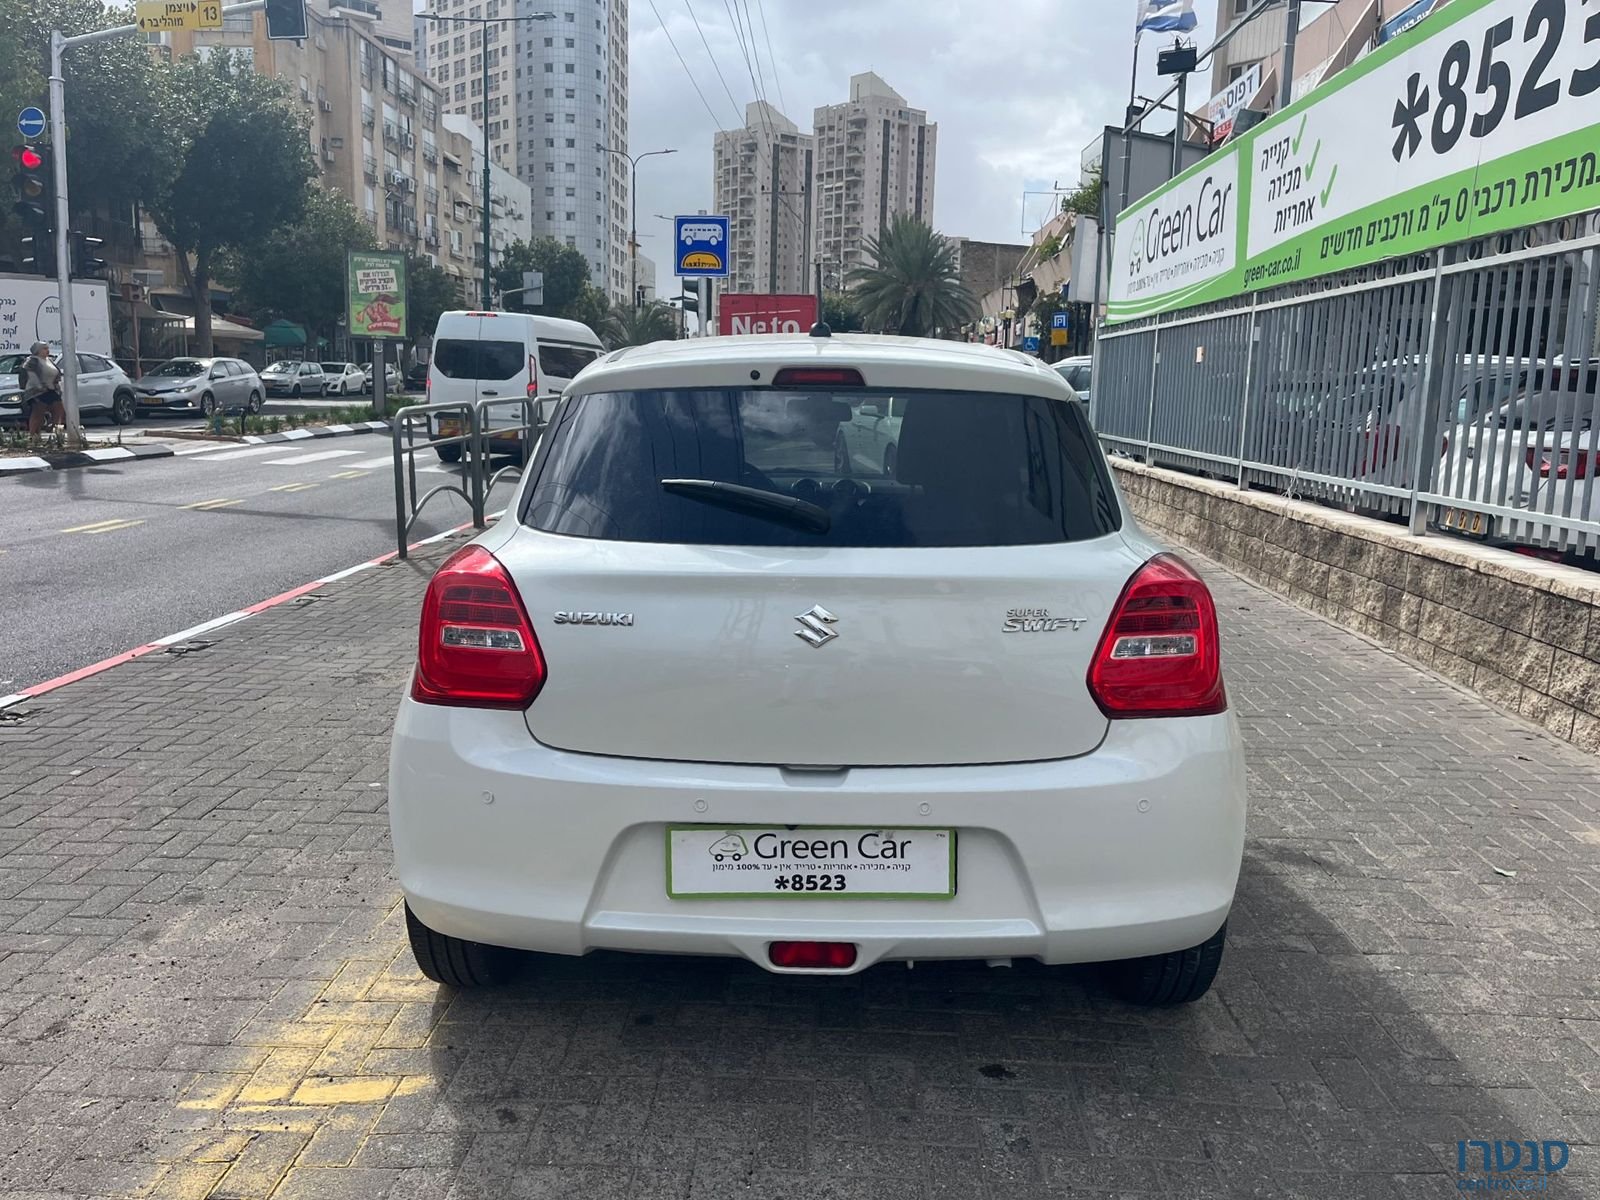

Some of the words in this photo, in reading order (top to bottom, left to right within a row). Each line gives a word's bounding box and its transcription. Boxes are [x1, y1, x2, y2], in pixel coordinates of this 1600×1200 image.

[165, 3, 189, 16] ויצמן
[203, 6, 218, 21] 13
[147, 15, 184, 27] מוהליבר
[1226, 73, 1254, 110] דפוס
[1261, 136, 1291, 172] קנייה
[1268, 165, 1302, 202] מכירה
[1520, 151, 1600, 206] מכירת
[1473, 178, 1516, 217] רכבי
[1146, 204, 1192, 264] Green
[1196, 176, 1232, 242] Car
[1273, 195, 1316, 234] אחריות
[1366, 208, 1415, 246] ורכבים
[1319, 226, 1363, 260] חדשים
[1243, 247, 1302, 289] green-car.co.il
[2, 325, 18, 337] לקוח
[731, 316, 800, 335] Neto
[553, 610, 635, 626] SUZUKI
[1006, 608, 1050, 618] SUPER
[1002, 617, 1087, 633] SWIFT
[753, 832, 849, 860] Green
[857, 832, 912, 860] Car
[712, 862, 734, 872] מימון
[736, 862, 760, 871] 100%
[761, 862, 772, 871] עד
[779, 862, 792, 872] אין
[794, 862, 816, 871] טרייד
[823, 862, 853, 871] אחריות
[859, 862, 885, 871] מכירה
[892, 862, 911, 872] קניה
